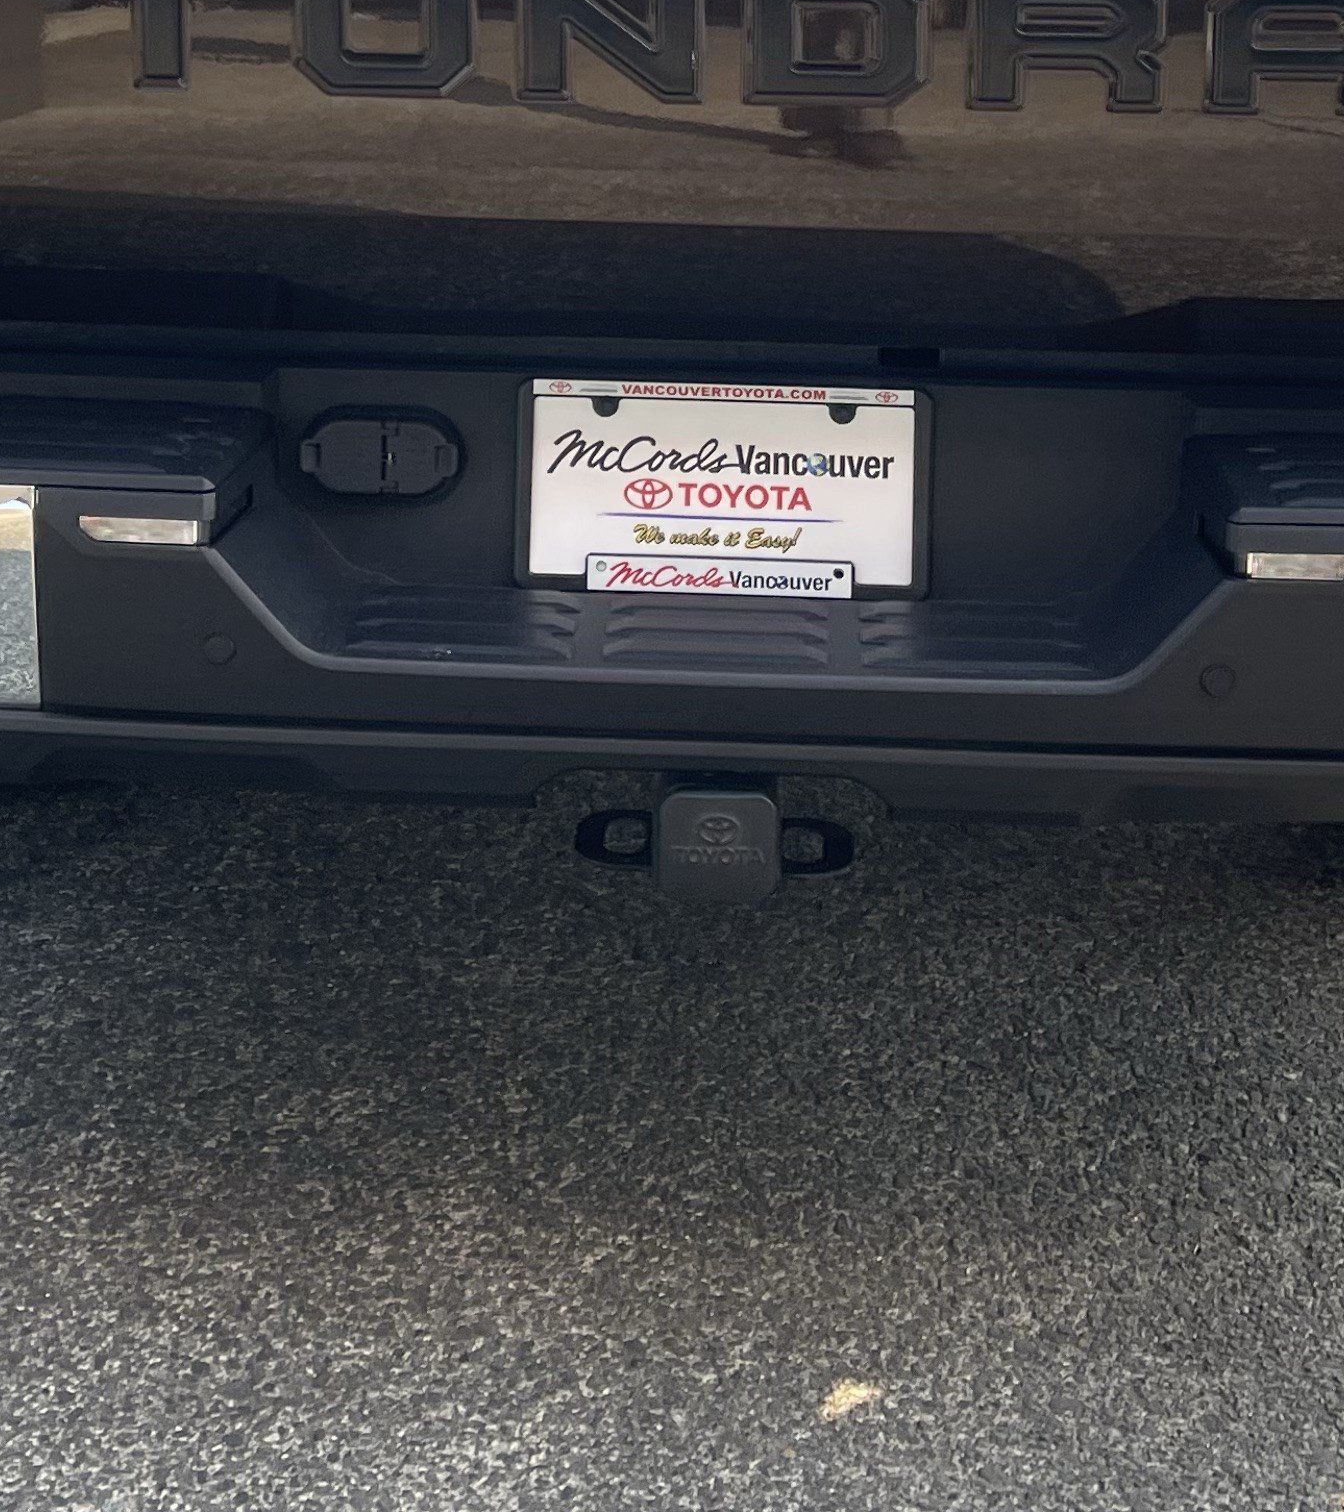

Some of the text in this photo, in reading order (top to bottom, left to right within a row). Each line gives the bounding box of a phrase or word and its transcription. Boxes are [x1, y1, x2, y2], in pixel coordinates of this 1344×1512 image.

[621, 383, 827, 401] VANCOUVERTOYOTA.COM
[678, 482, 812, 511] TOYOTA
[633, 523, 803, 554] We make it Easy!
